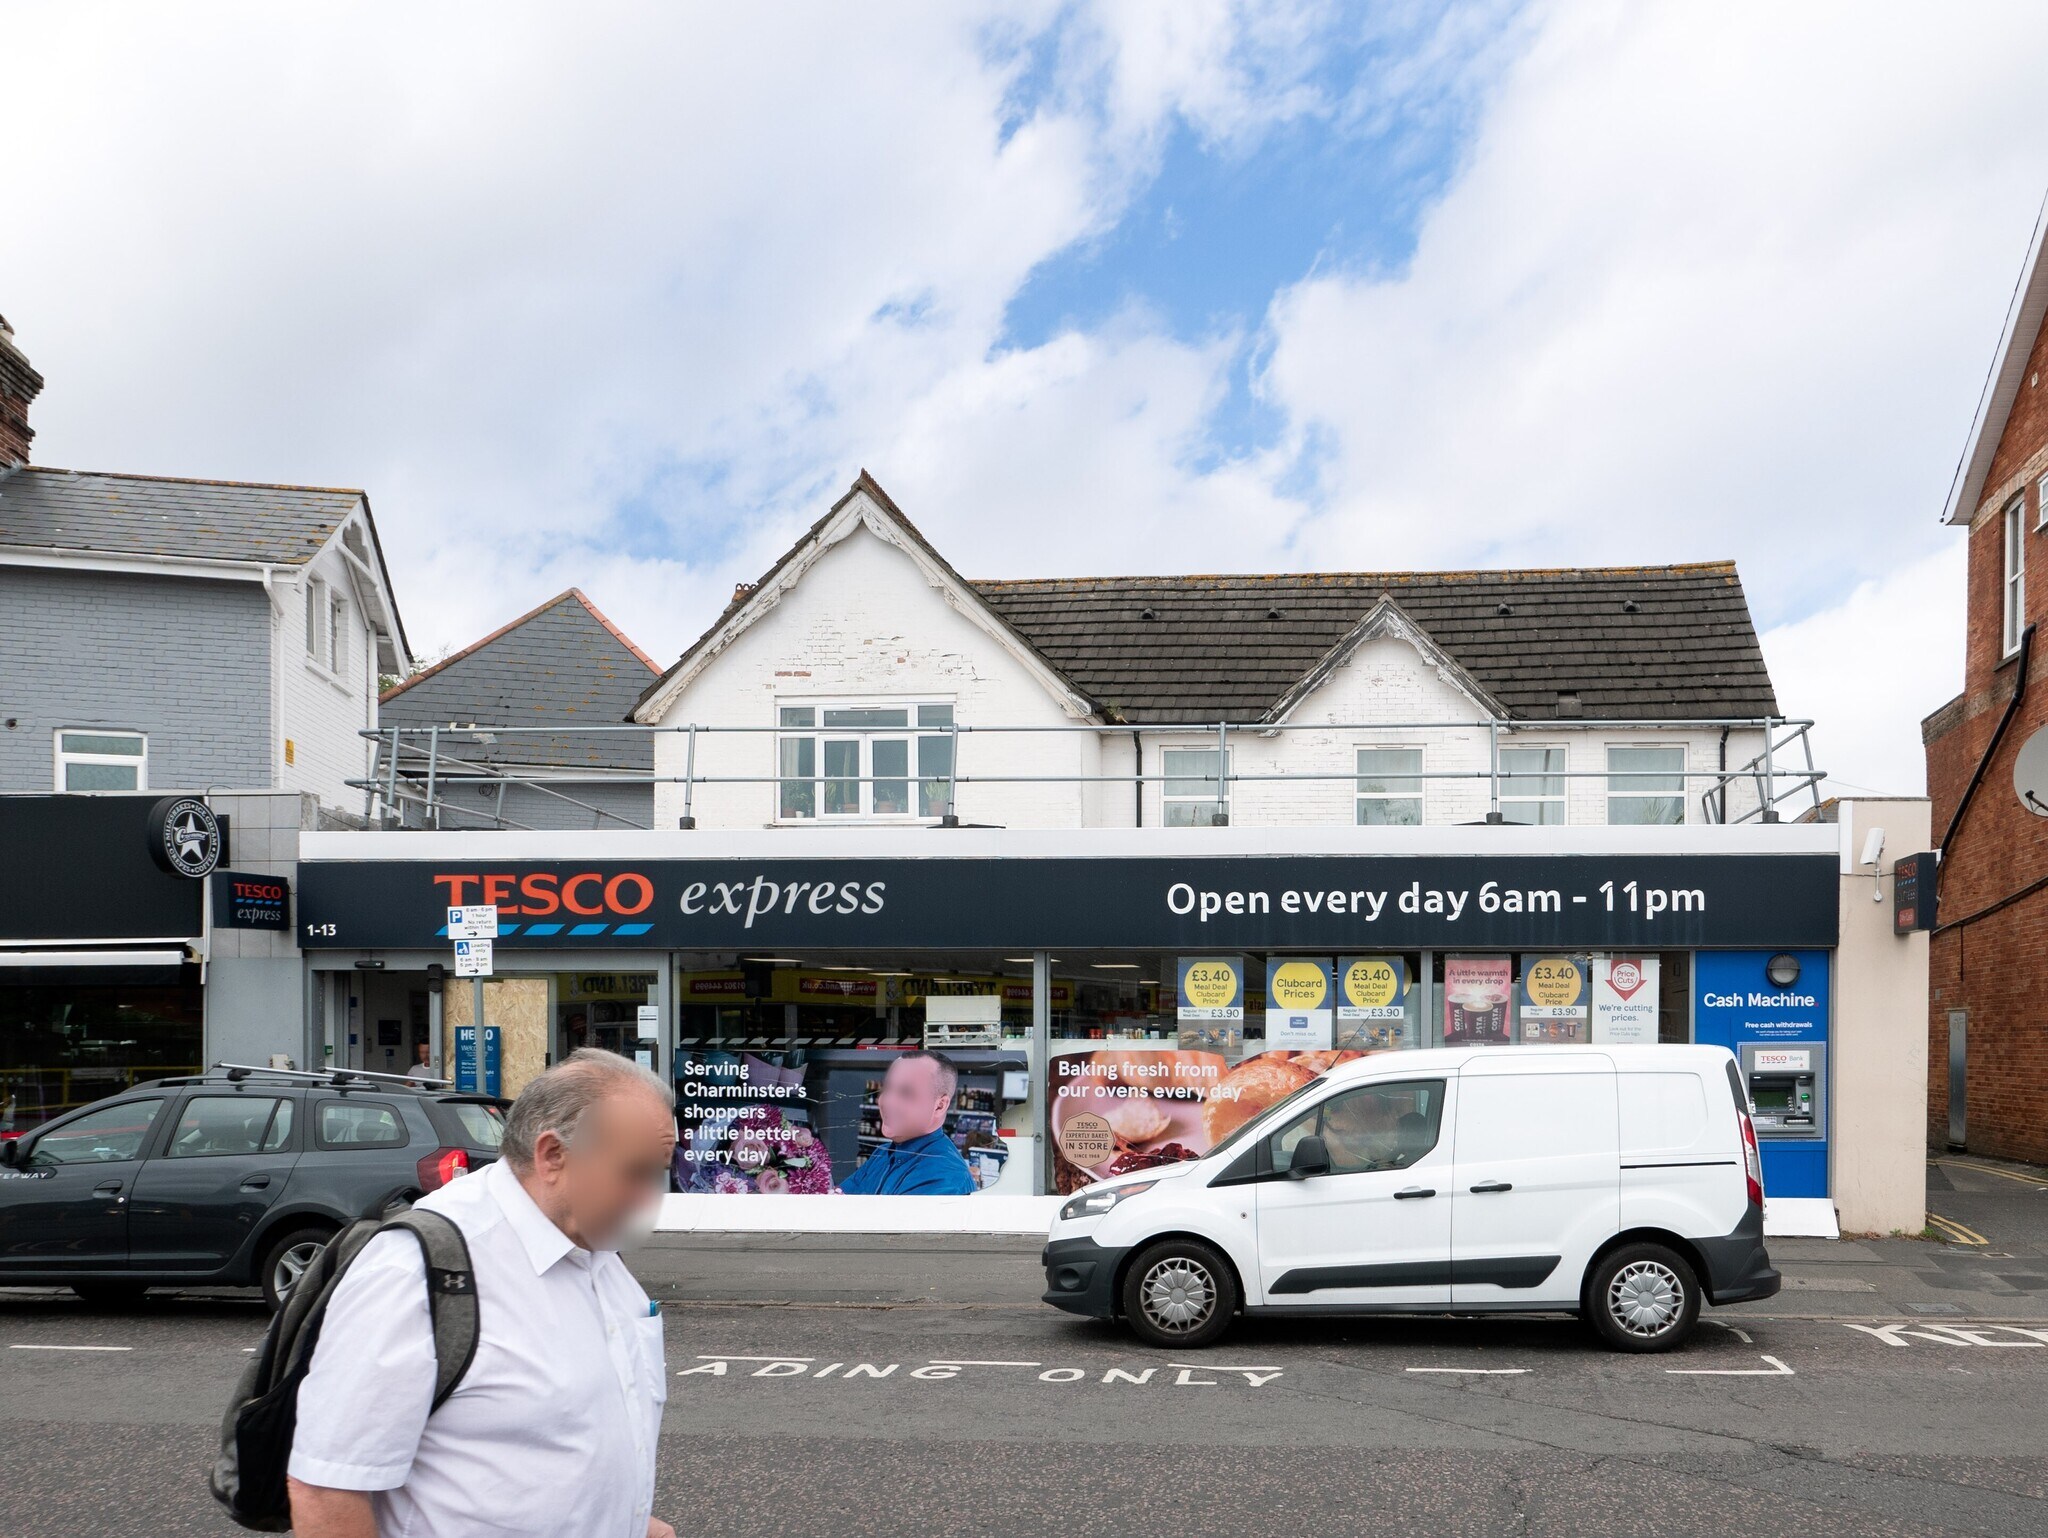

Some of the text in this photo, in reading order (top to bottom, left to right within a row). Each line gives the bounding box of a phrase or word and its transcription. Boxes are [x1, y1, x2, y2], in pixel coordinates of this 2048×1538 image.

[166, 802, 192, 841] MILKSHAKES
[195, 804, 218, 846] ICE CREAM
[194, 850, 216, 874] COFFEE
[234, 883, 282, 899] TESCO
[434, 872, 886, 928] TESCO express
[1166, 882, 1270, 922] Open
[1281, 890, 1388, 922] every
[1398, 882, 1469, 921] day
[1478, 881, 1562, 913] 6am
[1598, 880, 1706, 920] 11pm
[237, 907, 281, 924] express
[452, 912, 462, 922] P
[306, 924, 337, 936] 1-13
[1192, 970, 1230, 981] £3.40
[1352, 969, 1390, 980] £3.40
[1535, 967, 1574, 979] £3.40
[1276, 979, 1322, 988] Clubcard
[1284, 989, 1315, 998] Prices
[1704, 993, 1743, 1007] Cash
[1211, 1009, 1239, 1018] £3.90
[1371, 1008, 1400, 1017] £3.90
[1552, 1008, 1577, 1016] £3.90
[1624, 1004, 1653, 1013] cutting
[461, 1029, 494, 1041] HEO
[684, 1060, 749, 1080] Serving
[1058, 1061, 1218, 1080] Baking fresh from
[684, 1082, 807, 1098] Charminster's
[1058, 1084, 1242, 1102] our ovens every day
[684, 1104, 766, 1123] shoppers
[684, 1126, 800, 1140] a little better
[684, 1147, 768, 1166] every day
[1038, 1368, 1284, 1387] ONLY
